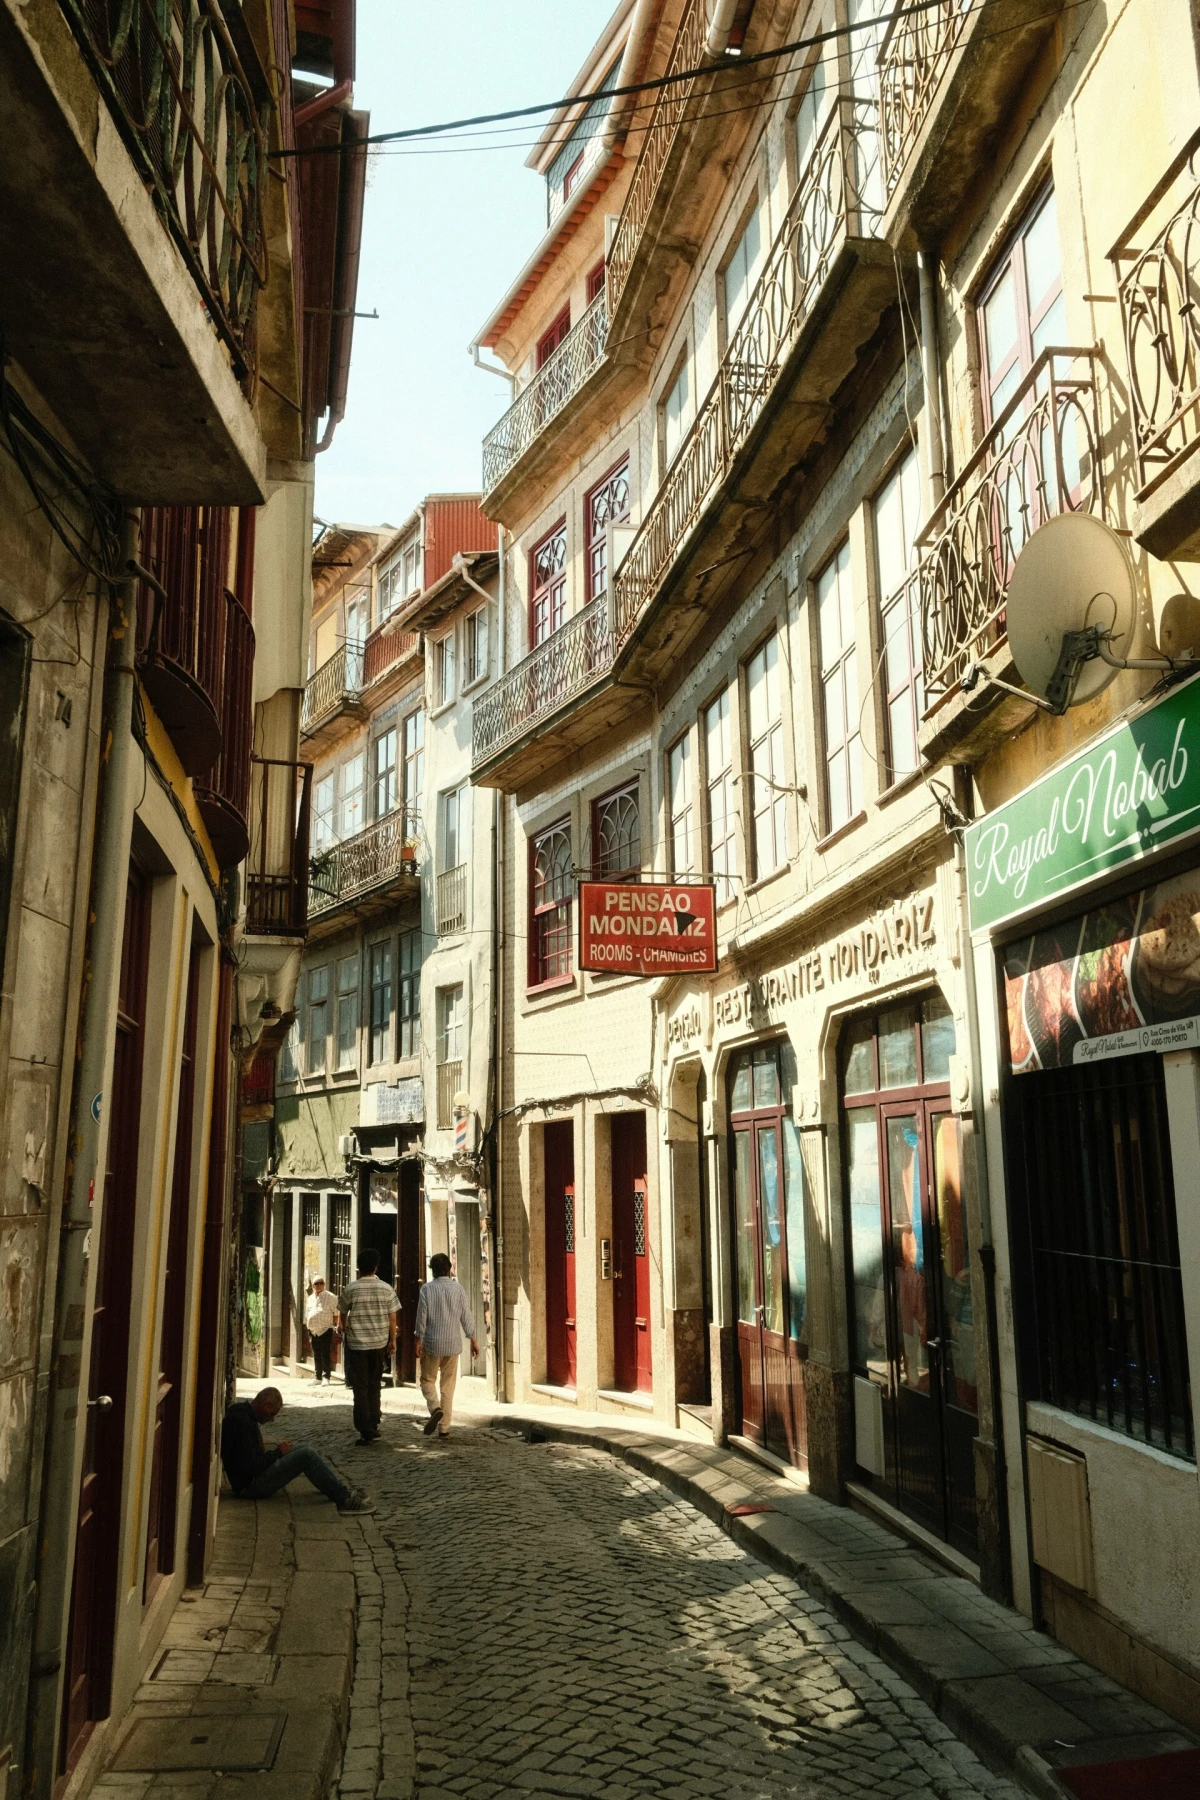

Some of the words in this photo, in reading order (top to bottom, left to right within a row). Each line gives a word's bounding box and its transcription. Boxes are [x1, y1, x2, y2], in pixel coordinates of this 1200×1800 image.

[974, 796, 1060, 899] Royal
[605, 888, 691, 913] PENSÃO
[590, 944, 633, 961] ROOMS
